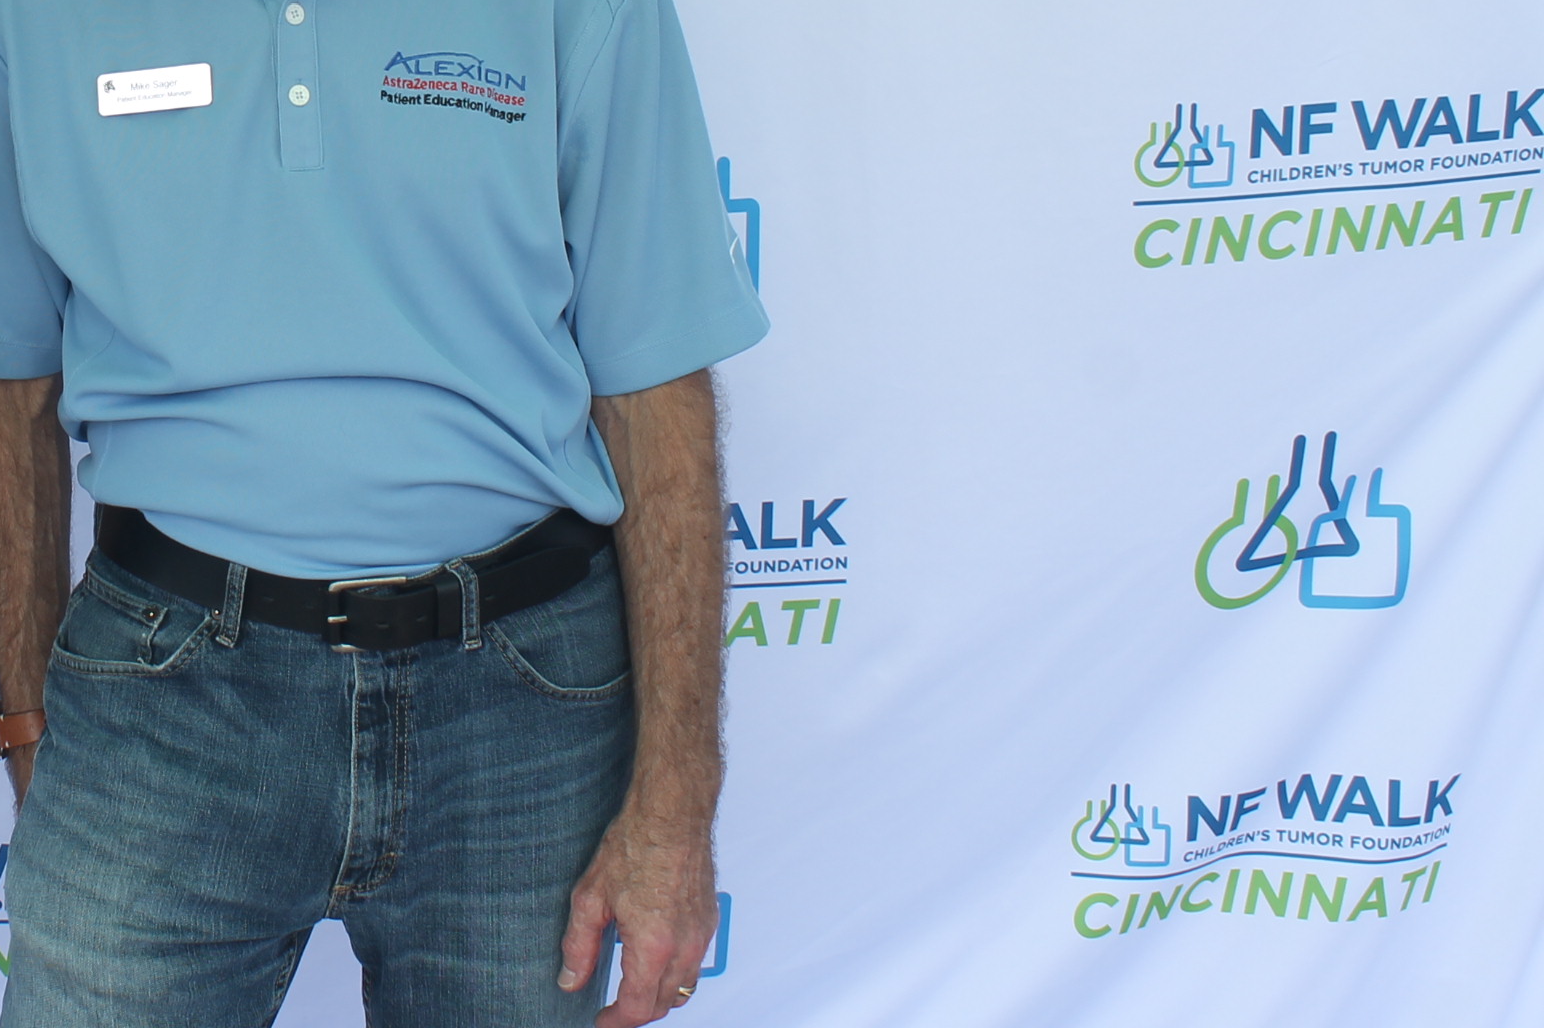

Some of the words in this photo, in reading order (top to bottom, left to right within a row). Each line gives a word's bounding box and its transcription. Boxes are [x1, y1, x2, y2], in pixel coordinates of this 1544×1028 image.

[382, 75, 458, 92] AstraZeneca
[461, 81, 486, 97] Rare
[487, 87, 526, 107] Disease
[384, 51, 526, 91] ALEXION
[380, 90, 421, 106] Patient
[423, 93, 484, 112] Education
[1249, 102, 1338, 160] NF
[1351, 88, 1544, 151] WALK
[1247, 162, 1354, 184] CHILDREN'S
[1359, 158, 1425, 175] TUMOR
[1430, 146, 1544, 171] FOUNDATION
[1133, 187, 1534, 269] CINCINNATI
[723, 497, 848, 551] ALK
[1186, 786, 1267, 843] NF
[1276, 772, 1462, 827] WALK
[1183, 829, 1271, 863] CHILDREN'S
[1276, 829, 1343, 848] TUMOR
[1350, 823, 1451, 851] FOUNDATION
[1073, 860, 1441, 939] CINCINNATI
